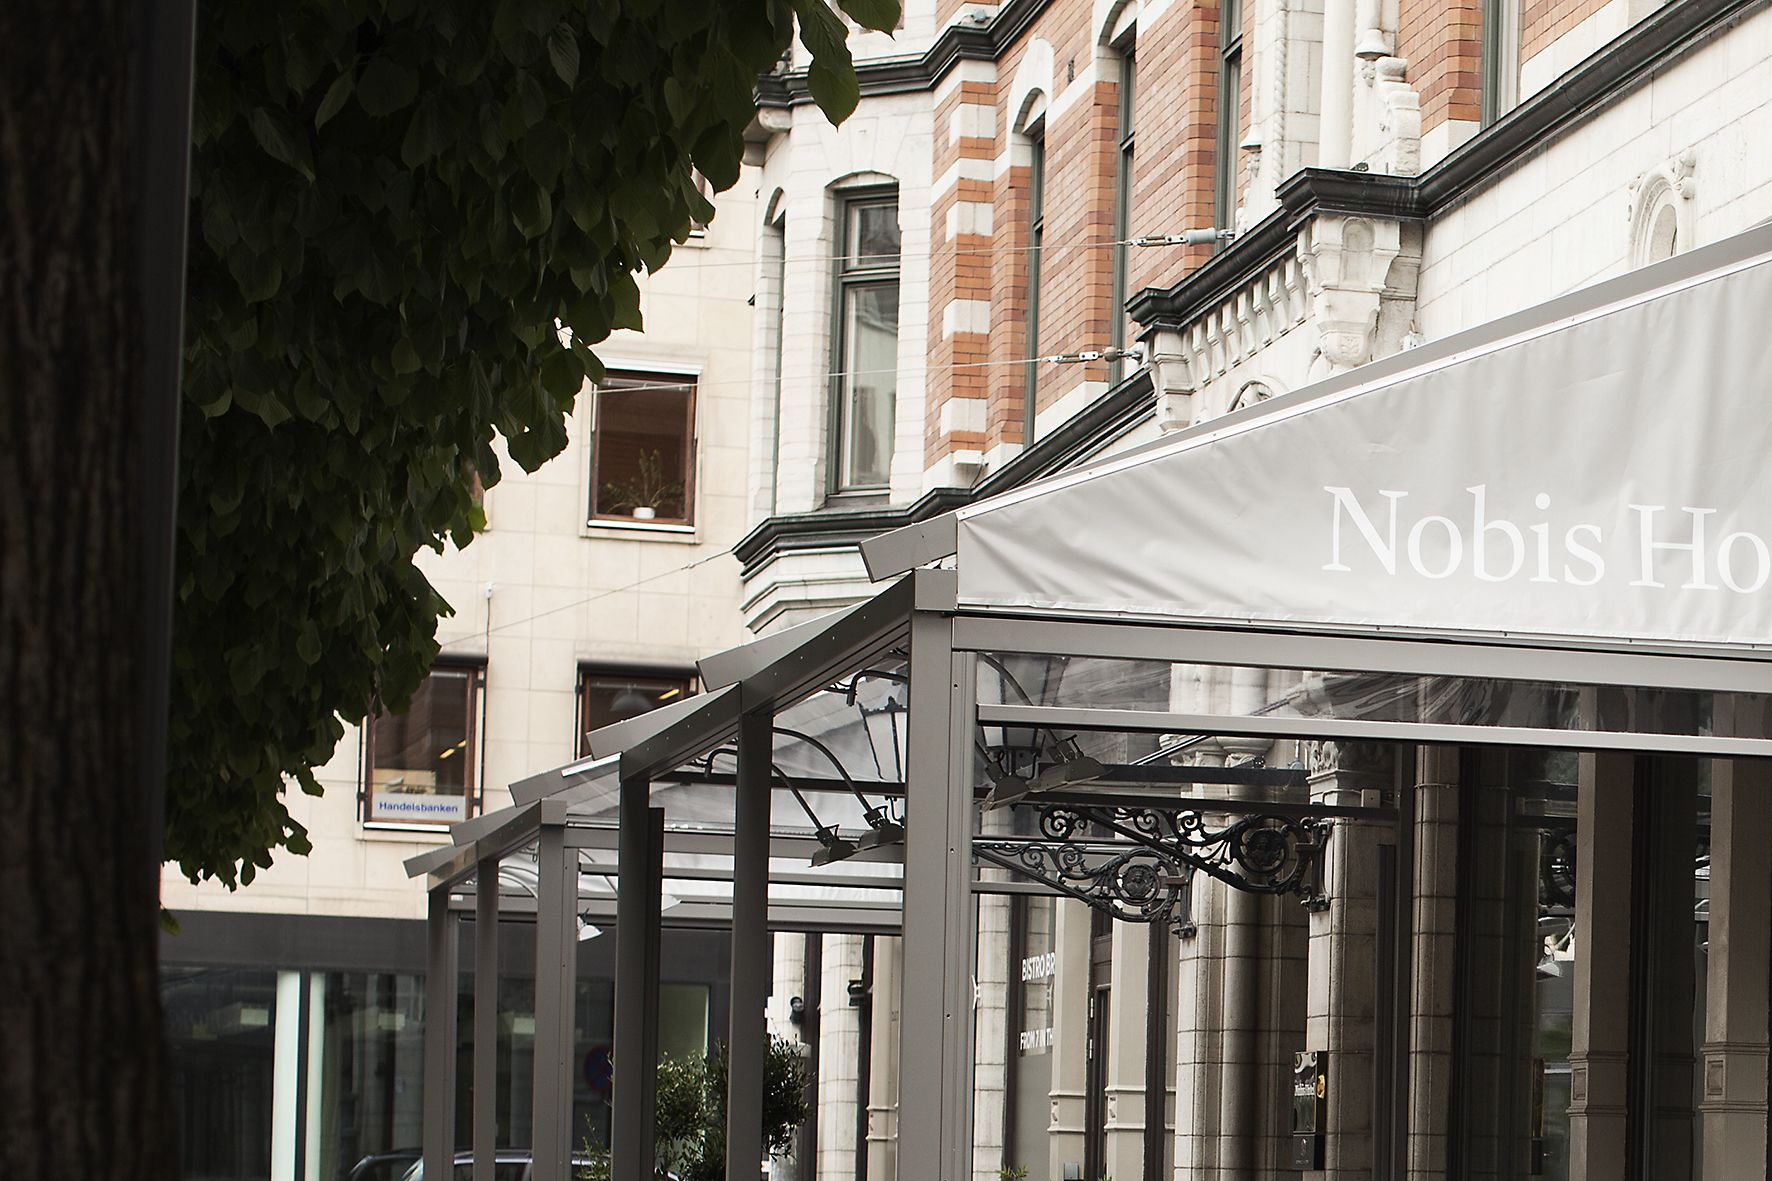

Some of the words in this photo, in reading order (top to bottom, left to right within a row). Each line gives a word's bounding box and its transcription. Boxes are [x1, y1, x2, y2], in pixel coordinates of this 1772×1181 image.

[1322, 484, 1606, 585] Nobis
[379, 802, 458, 813] Handelsbanken
[1022, 954, 1045, 981] BISTRO
[1046, 952, 1056, 976] BR
[1020, 1031, 1034, 1050] FROM
